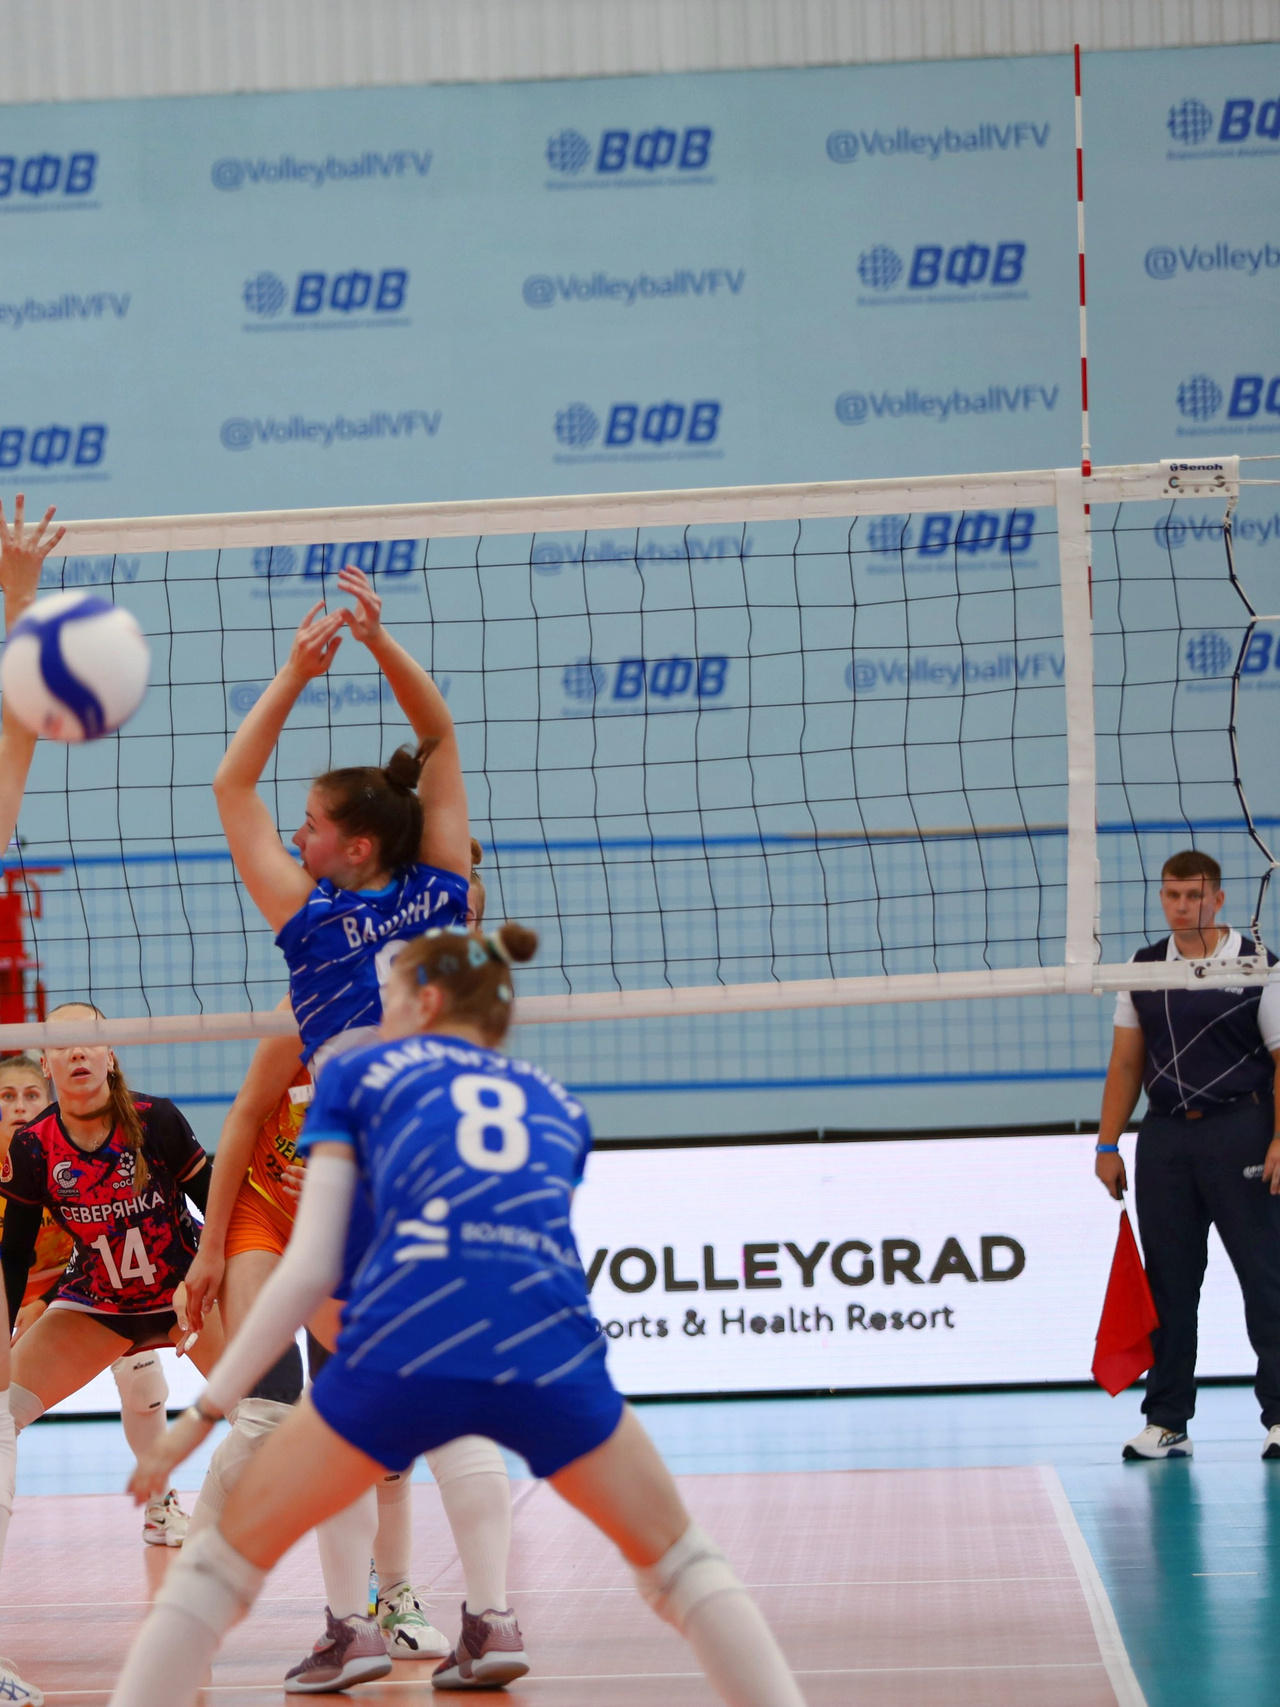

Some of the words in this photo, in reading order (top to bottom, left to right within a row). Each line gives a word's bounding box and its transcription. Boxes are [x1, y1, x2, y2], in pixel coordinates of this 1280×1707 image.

[826, 122, 1051, 163] @VolleyballVFV
[1218, 97, 1280, 143] ВФ
[211, 151, 433, 191] @VolleyballVFV
[596, 127, 713, 173] ВФВ
[908, 242, 1026, 289] ВФВ
[1144, 242, 1280, 280] @Volleyb
[293, 269, 408, 315] ВФВ
[523, 269, 746, 309] @VolleyballVFV
[604, 401, 721, 447] ВФВ
[835, 385, 1060, 426] @VolleyballVFV
[220, 411, 442, 451] @VolleyballVFV
[918, 512, 1035, 557] ВФВ
[611, 655, 729, 701] ВФВ
[450, 1073, 530, 1173] 8
[60, 1191, 165, 1223] СЕВЕРЯНКА
[91, 1227, 157, 1289] 14
[600, 1315, 668, 1339] orts
[682, 1309, 706, 1336] &
[721, 1305, 833, 1335] Health
[848, 1304, 955, 1331] Resort
